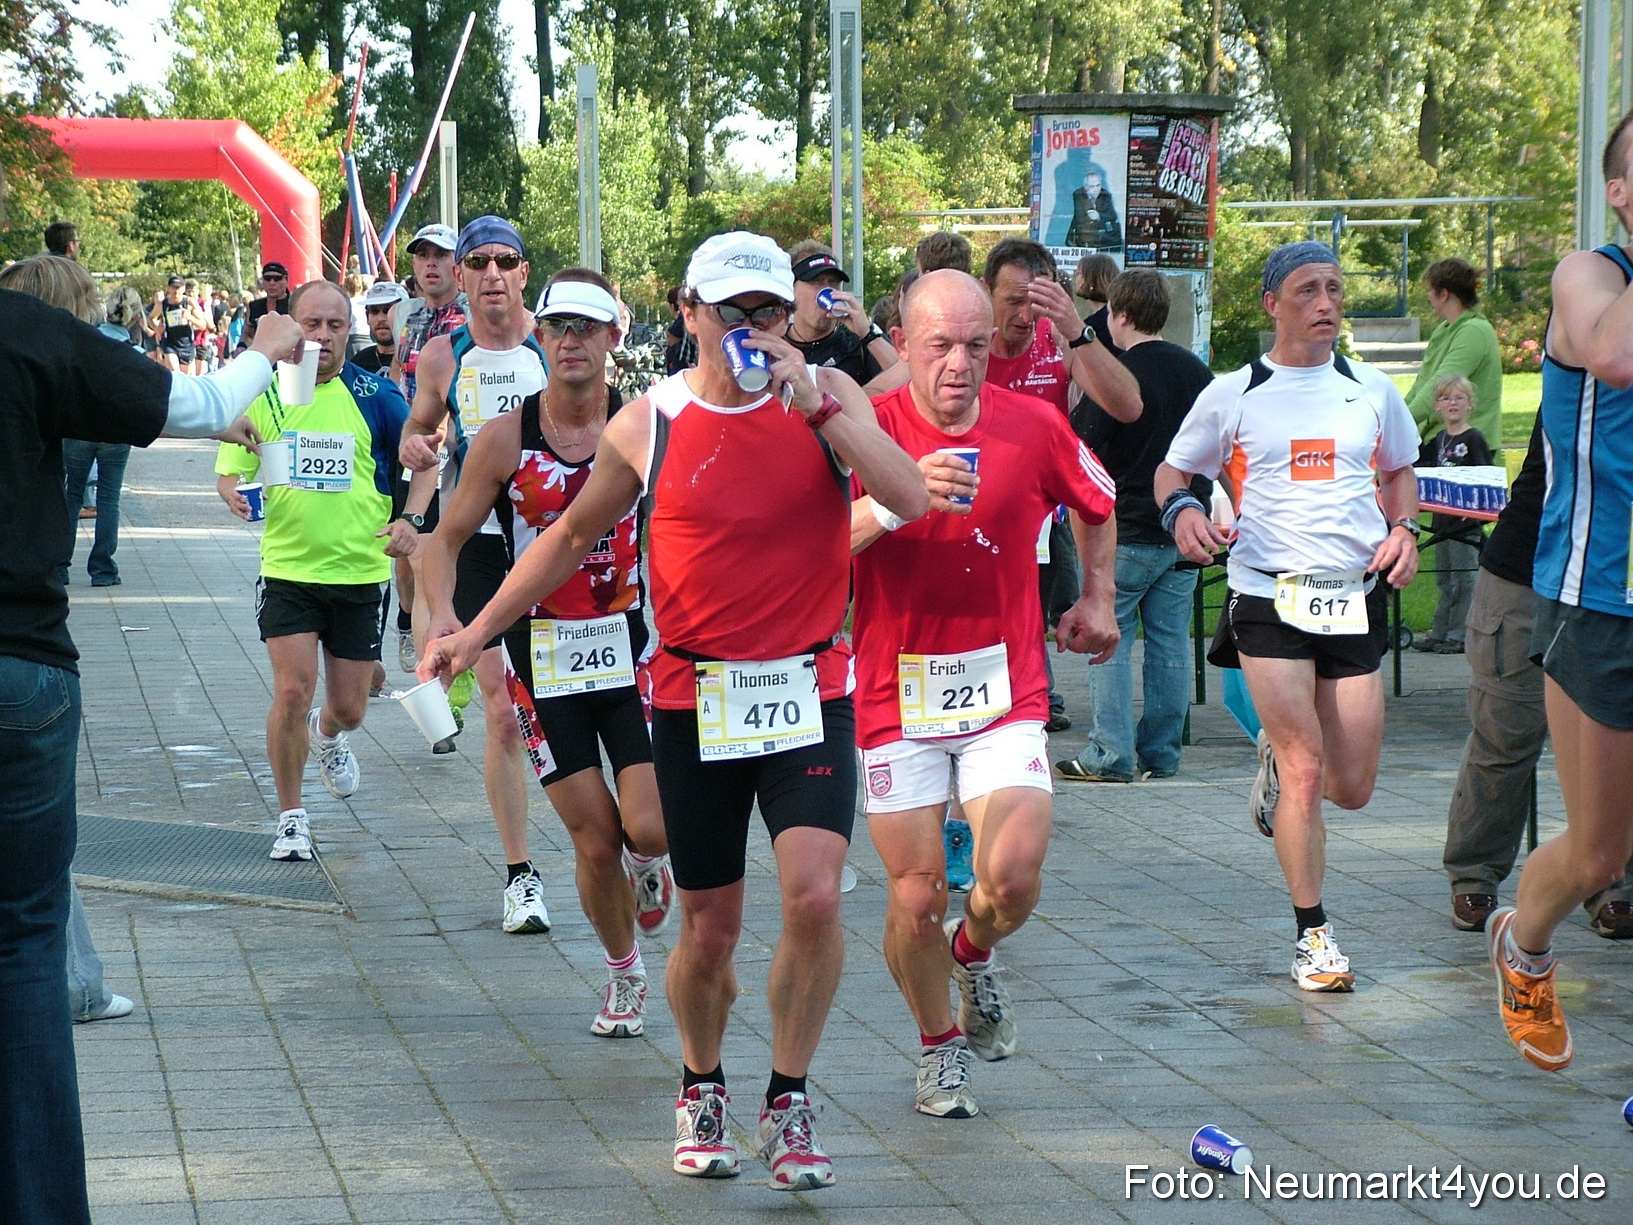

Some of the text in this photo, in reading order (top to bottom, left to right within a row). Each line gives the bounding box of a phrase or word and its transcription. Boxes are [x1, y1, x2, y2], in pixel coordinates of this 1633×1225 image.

[1053, 120, 1081, 131] Bruno
[1046, 127, 1101, 158] Jonas
[1159, 168, 1206, 206] 08.09.07
[480, 371, 516, 386] Roland
[464, 393, 470, 403] A
[497, 394, 522, 414] 20
[300, 436, 344, 450] Stanislav
[301, 457, 348, 476] 2923
[1295, 451, 1331, 467] GfK
[1302, 574, 1344, 590] Thomas
[1280, 589, 1285, 599] A
[1309, 597, 1350, 617] 617
[536, 650, 542, 661] A
[569, 646, 617, 673] 246
[930, 659, 966, 676] Erich
[595, 674, 634, 686] PFLEIDERER
[730, 670, 788, 689] Thomas
[904, 684, 912, 697] B
[941, 682, 989, 711] 221
[703, 700, 711, 715] A
[743, 699, 801, 730] 470
[702, 743, 749, 757] BOCK
[776, 731, 822, 747] PFLEIDERER
[807, 766, 834, 776] LEX
